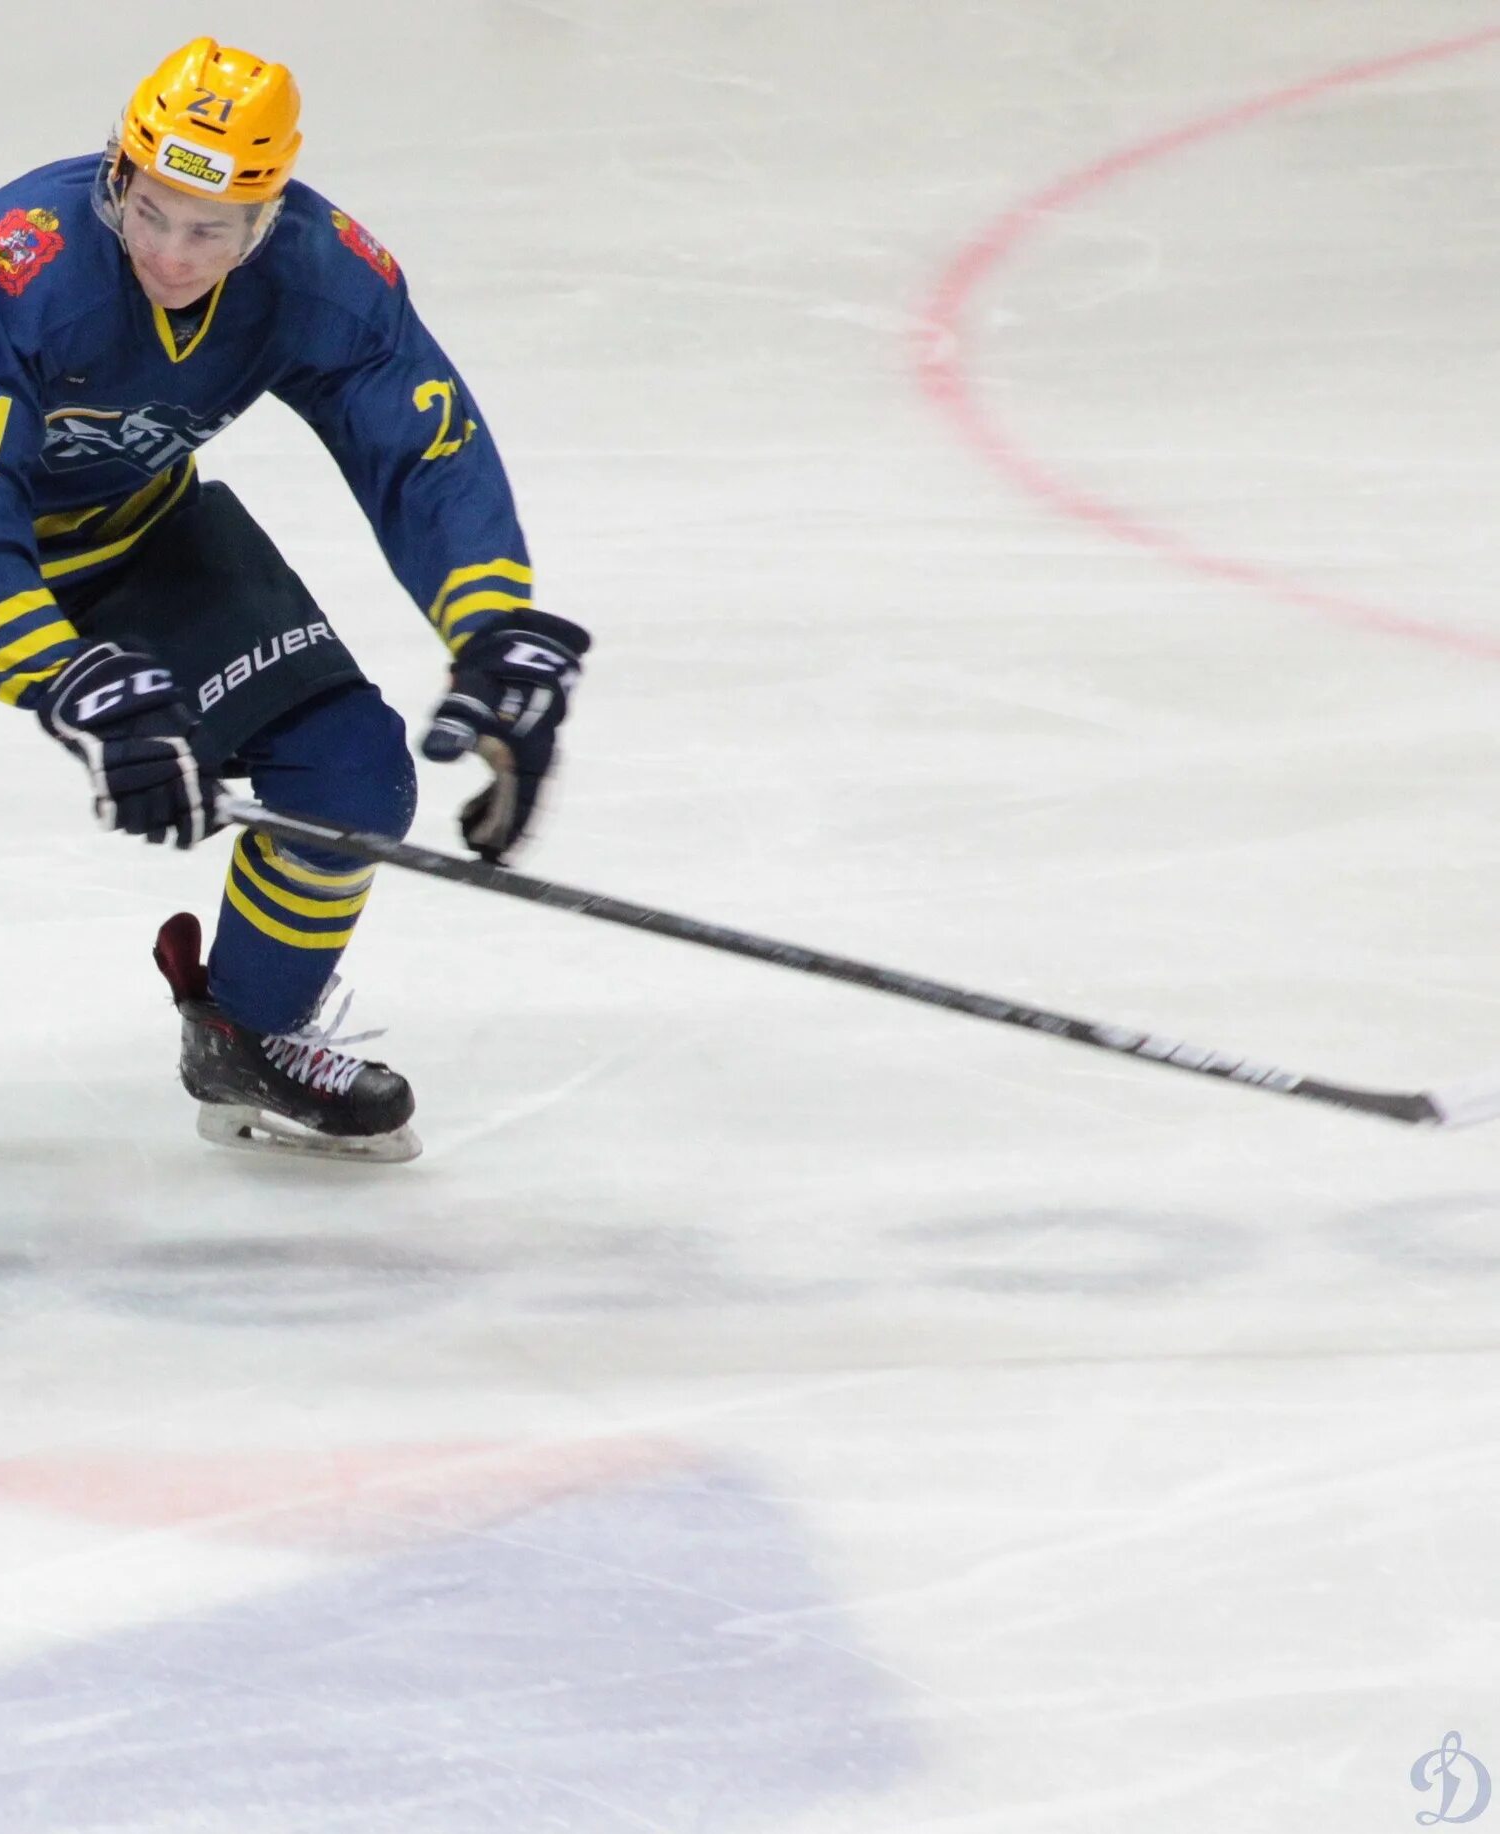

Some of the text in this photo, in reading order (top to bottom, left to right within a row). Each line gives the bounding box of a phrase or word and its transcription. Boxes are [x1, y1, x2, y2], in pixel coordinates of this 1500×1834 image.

[186, 87, 234, 123] 21
[168, 157, 223, 183] MATCH
[412, 379, 478, 461] 2
[198, 621, 337, 714] BAUER
